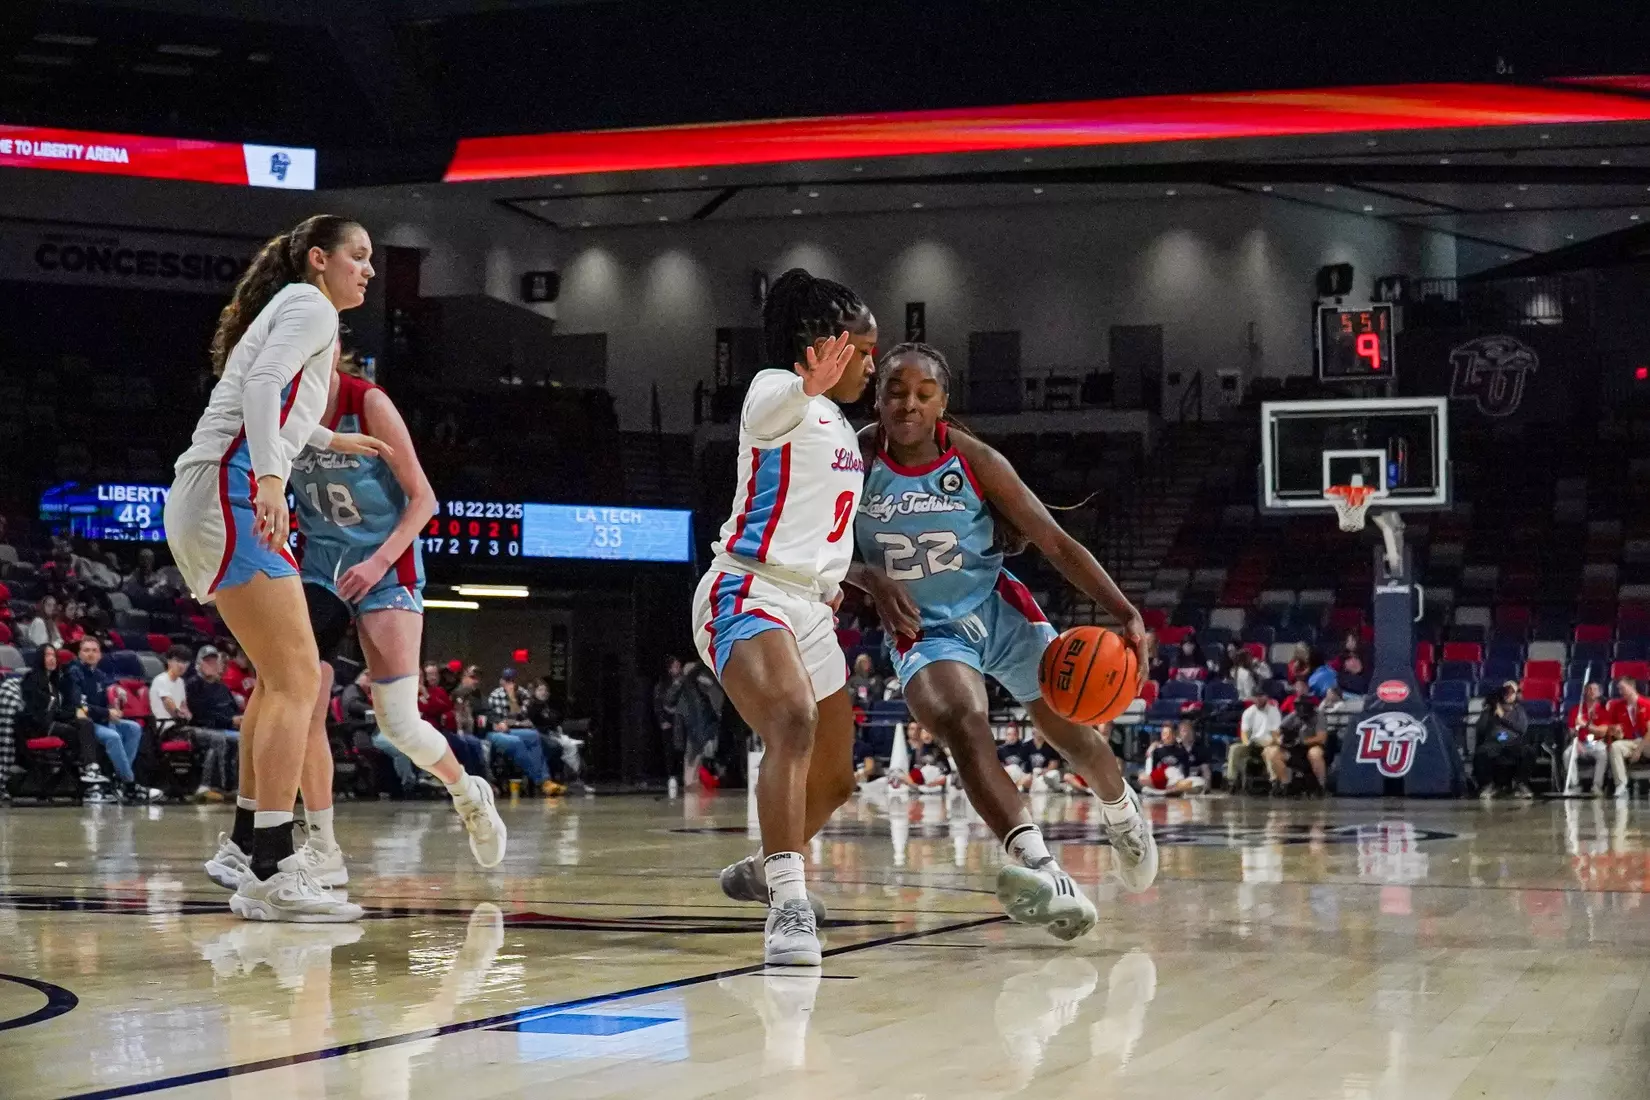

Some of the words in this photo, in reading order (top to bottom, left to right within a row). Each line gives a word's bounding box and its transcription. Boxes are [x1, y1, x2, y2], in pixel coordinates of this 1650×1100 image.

[14, 140, 32, 156] TO
[34, 142, 84, 159] LIBERTY
[85, 146, 129, 163] ARENA
[36, 243, 246, 282] CONCESSIO
[1356, 332, 1382, 369] 9
[98, 485, 170, 503] LIBERTY
[305, 482, 362, 527] 18
[118, 503, 151, 529] 48
[447, 501, 464, 517] 18
[466, 502, 484, 518] 22
[485, 503, 504, 518] 23
[505, 504, 523, 519] 25
[576, 507, 597, 522] LA
[602, 509, 642, 524] TECH
[858, 494, 897, 524] Lady
[429, 520, 440, 535] 2
[449, 521, 460, 536] 0
[469, 521, 480, 536] 0
[489, 522, 500, 537] 2
[511, 523, 519, 538] 1
[594, 525, 622, 548] 33
[427, 538, 443, 553] 17
[449, 539, 460, 554] 2
[469, 539, 479, 554] 7
[489, 540, 499, 555] 3
[508, 541, 519, 556] 0
[874, 530, 964, 581] 22
[1057, 638, 1087, 691] ELITE
[1355, 723, 1418, 778] LU
